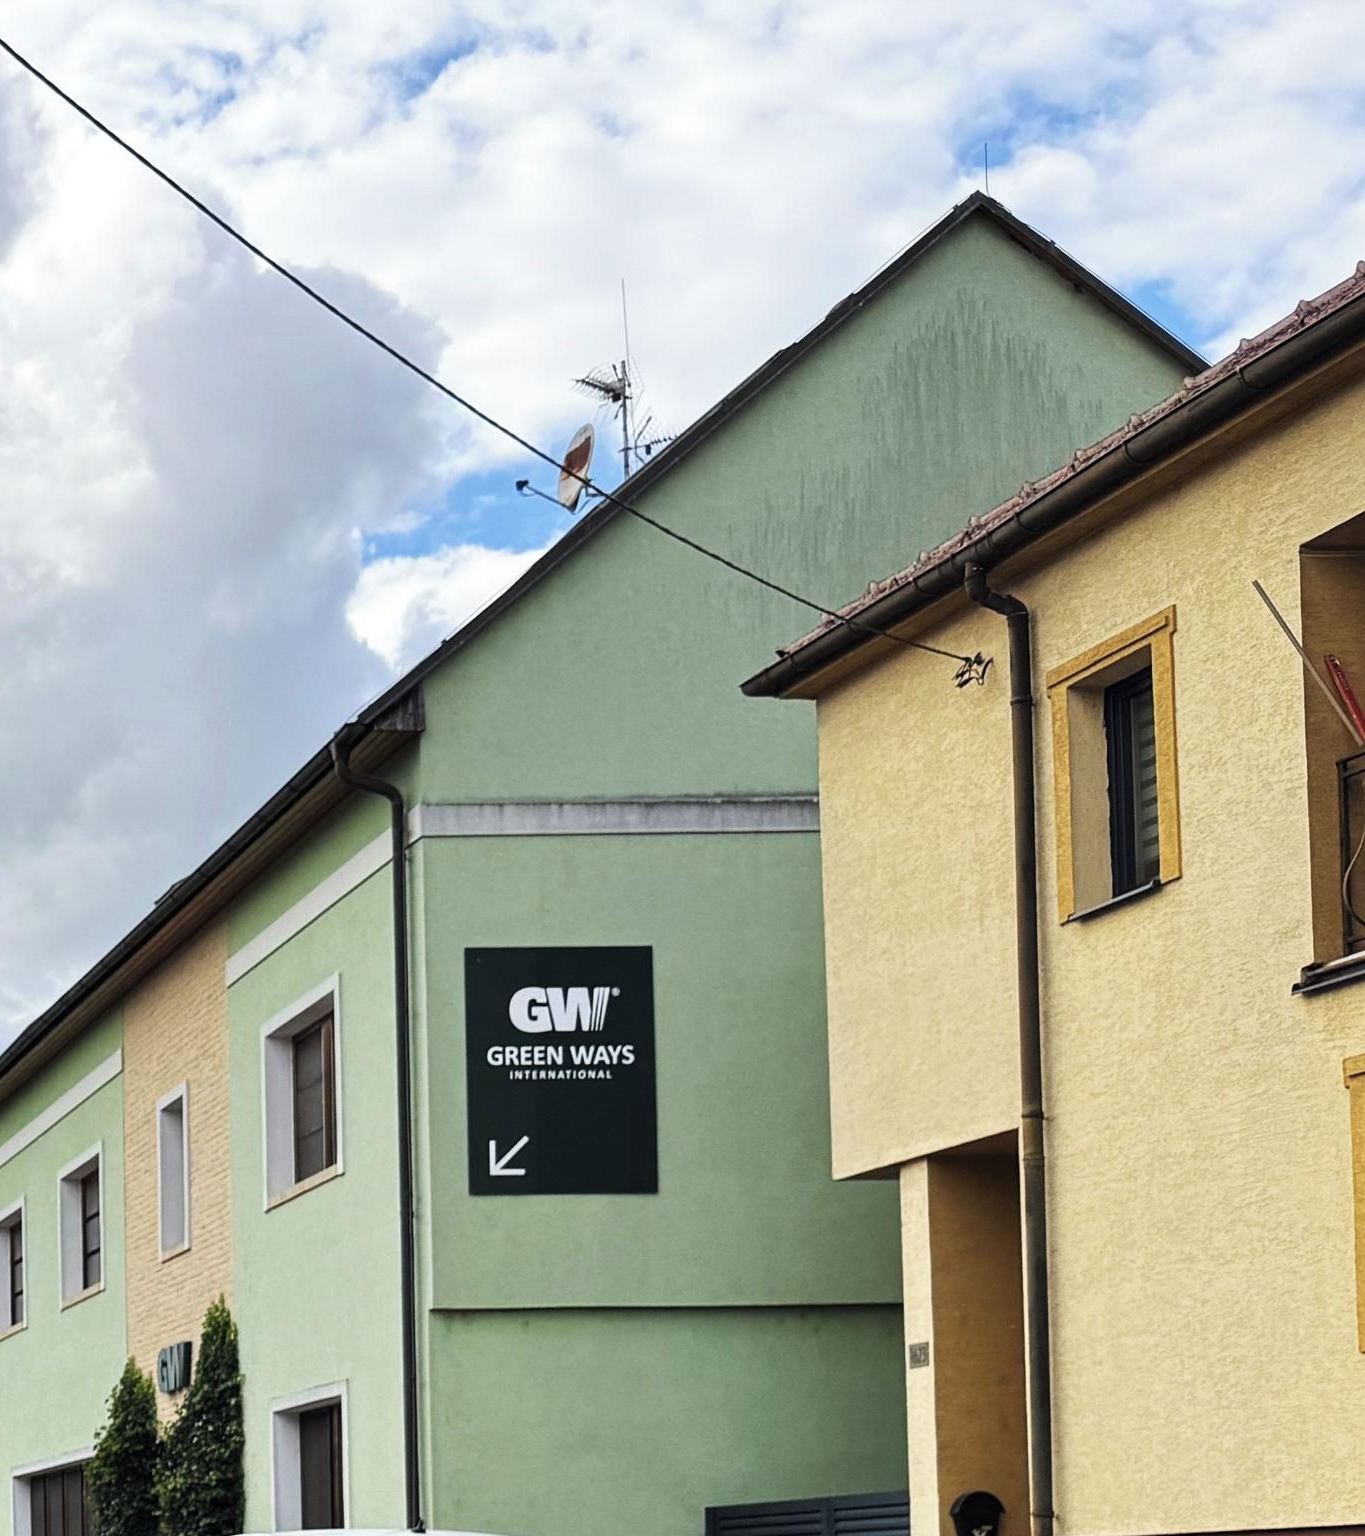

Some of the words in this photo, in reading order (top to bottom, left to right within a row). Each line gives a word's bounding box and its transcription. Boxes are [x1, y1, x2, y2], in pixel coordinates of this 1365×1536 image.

[486, 1046, 563, 1066] GREEN
[570, 1044, 636, 1065] WAYS
[509, 1069, 613, 1081] INTERNATIONAL
